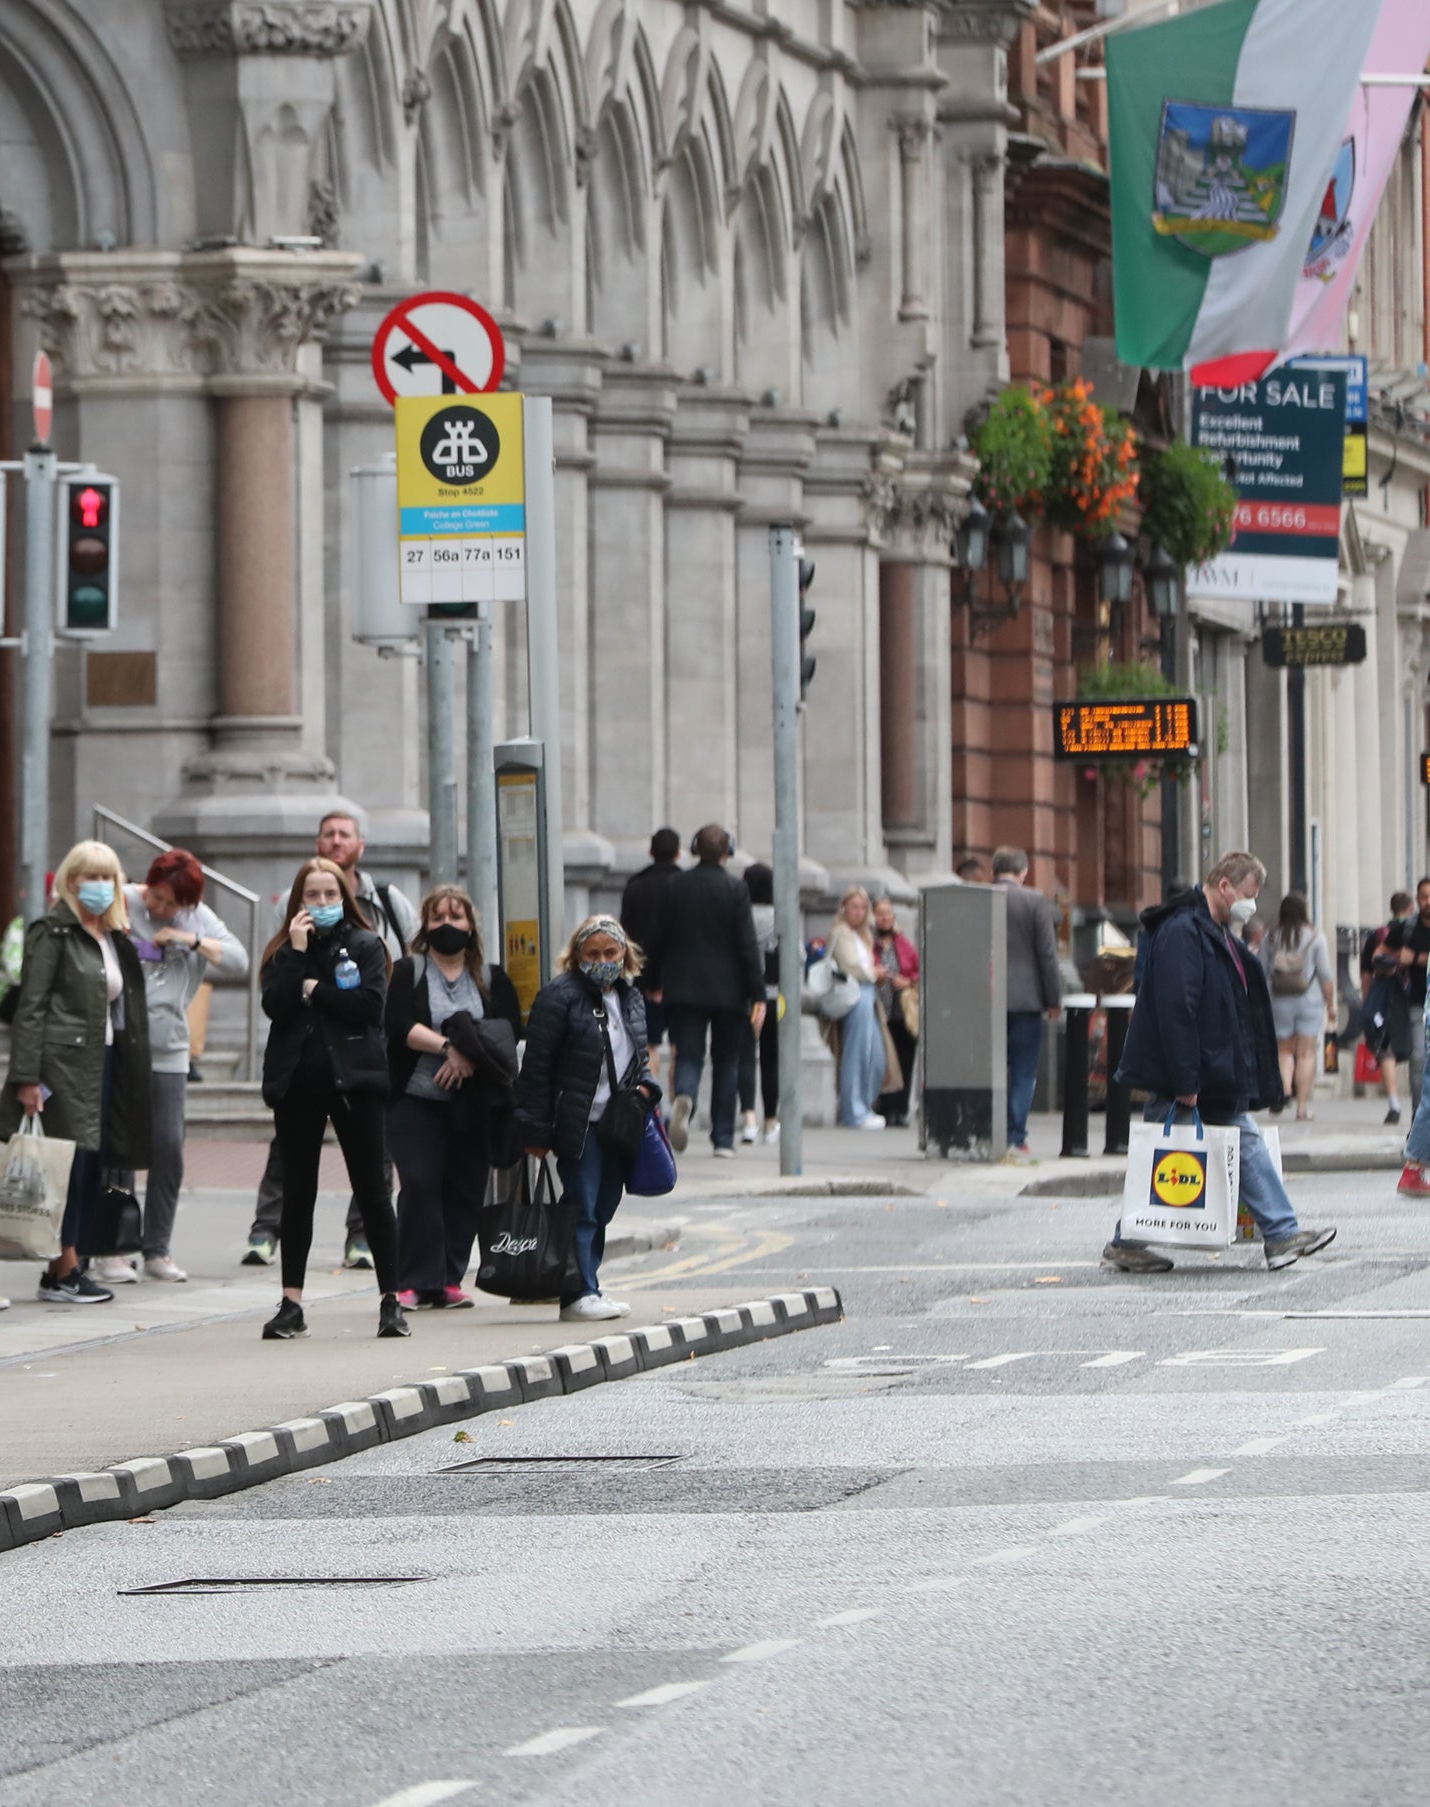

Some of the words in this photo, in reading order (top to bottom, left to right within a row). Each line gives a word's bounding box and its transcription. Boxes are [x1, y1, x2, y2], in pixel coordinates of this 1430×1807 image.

[1266, 380, 1336, 409] SALE
[1199, 412, 1263, 431] Excellent
[1198, 431, 1300, 451] Refurbishment
[446, 465, 474, 478] BUS
[438, 488, 460, 498] Stop
[433, 520, 463, 531] College
[465, 519, 490, 529] Green
[407, 551, 423, 563] 27
[434, 550, 459, 562] 56a
[465, 549, 490, 561] 77a
[497, 548, 520, 560] 151
[1281, 628, 1347, 644] TESCO
[1136, 1218, 1167, 1228] MORE
[1170, 1219, 1191, 1230] FOR
[1194, 1222, 1217, 1232] YOU
